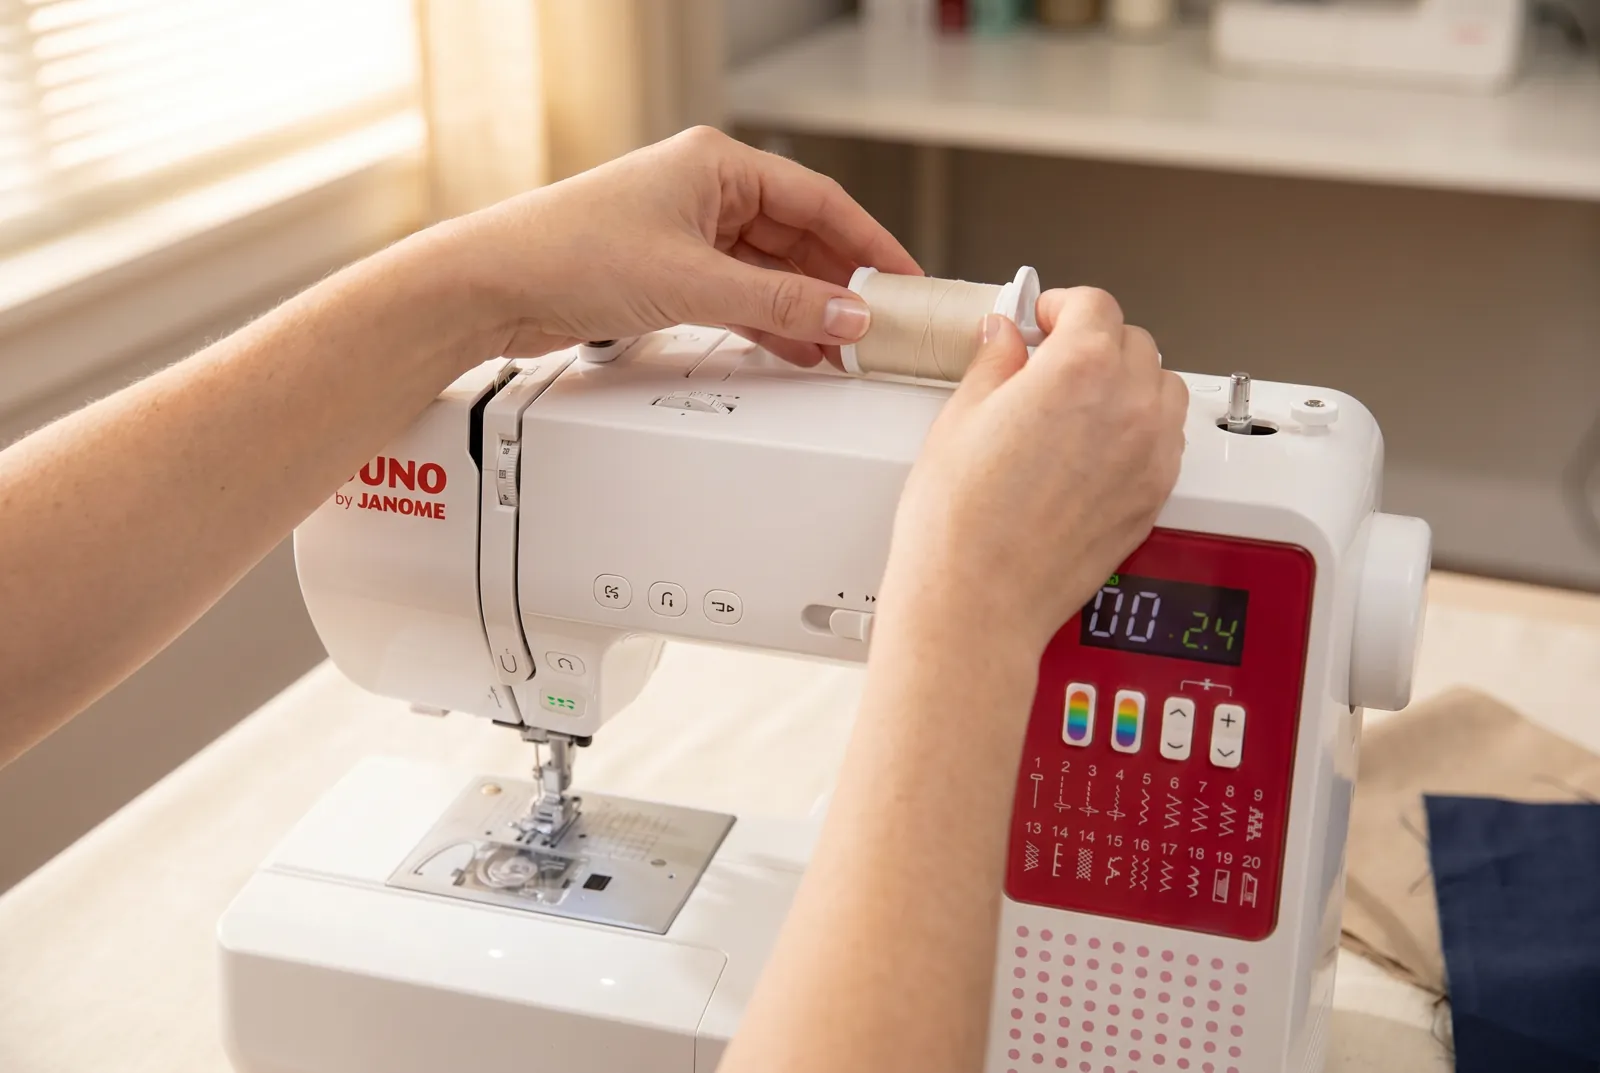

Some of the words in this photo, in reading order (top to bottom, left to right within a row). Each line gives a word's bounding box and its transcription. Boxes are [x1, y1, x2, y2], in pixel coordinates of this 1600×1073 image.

[348, 456, 447, 494] UNO
[335, 491, 353, 509] by
[357, 493, 446, 520] JANOME
[1089, 587, 1161, 643] 00
[1182, 611, 1239, 651] 2.4
[1035, 758, 1040, 767] 1
[1062, 761, 1070, 772] 2
[1088, 765, 1097, 776] 3
[1116, 770, 1124, 780] 4
[1142, 773, 1151, 784] 5
[1170, 778, 1179, 789] 6
[1199, 781, 1207, 792] 7
[1225, 786, 1234, 797] 8
[1254, 790, 1263, 800] 9
[1026, 822, 1041, 834] 13
[1053, 826, 1068, 838] 14
[1079, 830, 1095, 842] 14
[1107, 835, 1122, 847] 15
[1133, 839, 1149, 851] 16
[1161, 843, 1177, 855] 17
[1188, 848, 1204, 859] 18
[1216, 852, 1232, 864] 19
[1242, 856, 1261, 868] 20
